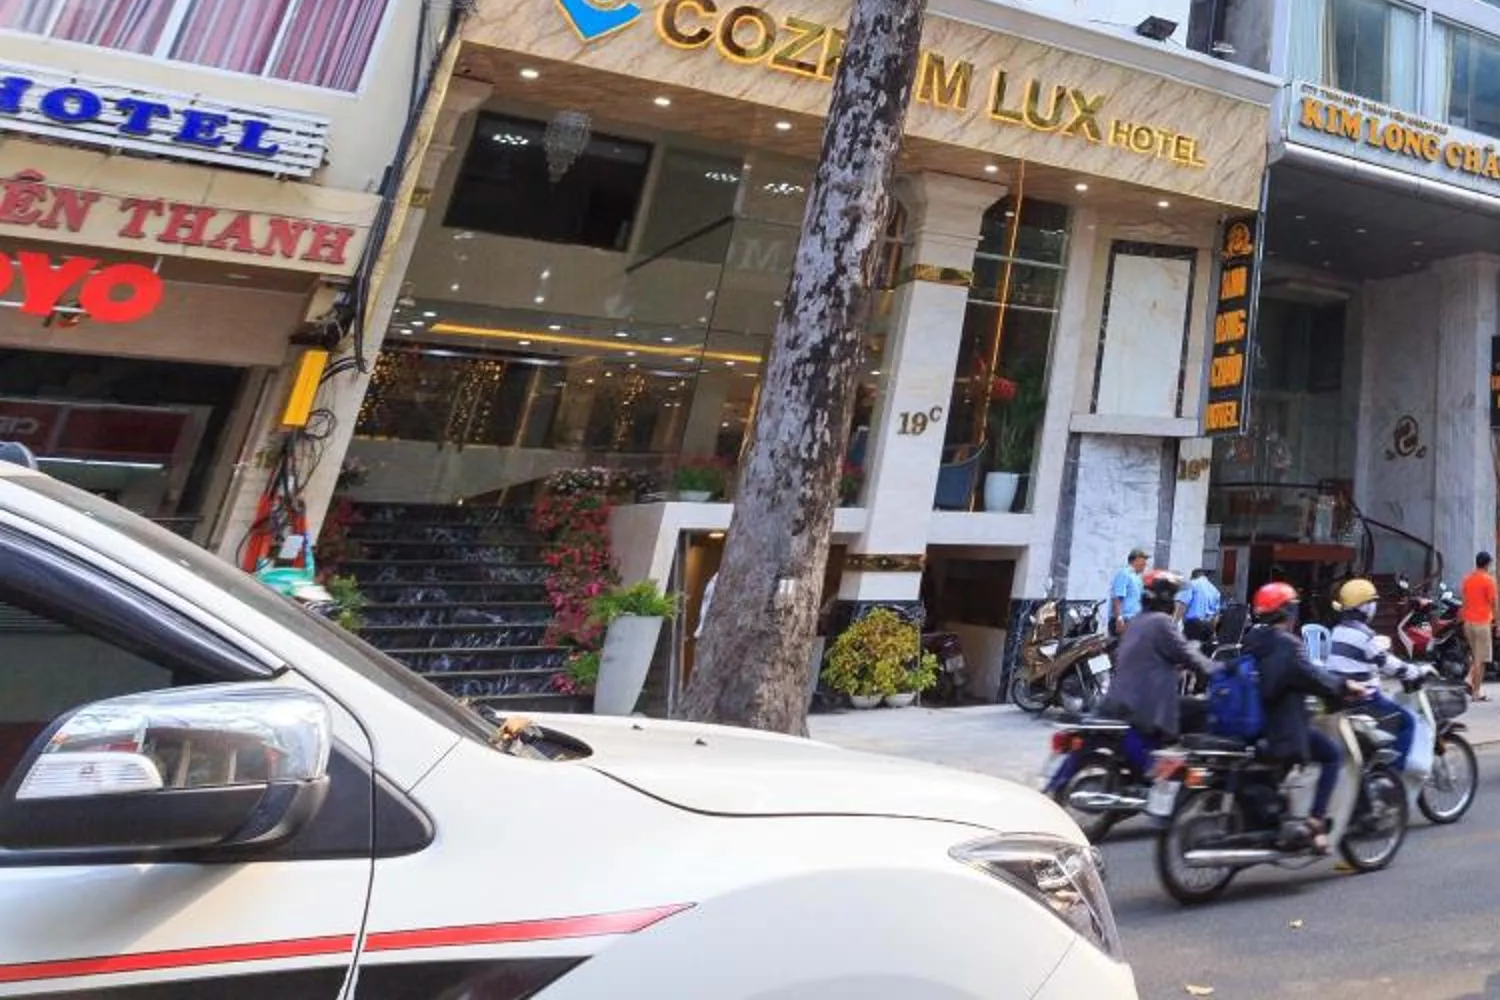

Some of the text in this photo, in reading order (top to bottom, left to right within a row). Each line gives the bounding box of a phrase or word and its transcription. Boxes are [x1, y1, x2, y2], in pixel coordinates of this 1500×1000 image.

[988, 69, 1105, 142] LUX
[1109, 119, 1206, 168] HOTEL
[1301, 96, 1362, 141] KIM
[1365, 115, 1442, 163] LONG
[117, 197, 354, 266] THANH
[0, 248, 165, 324] YO
